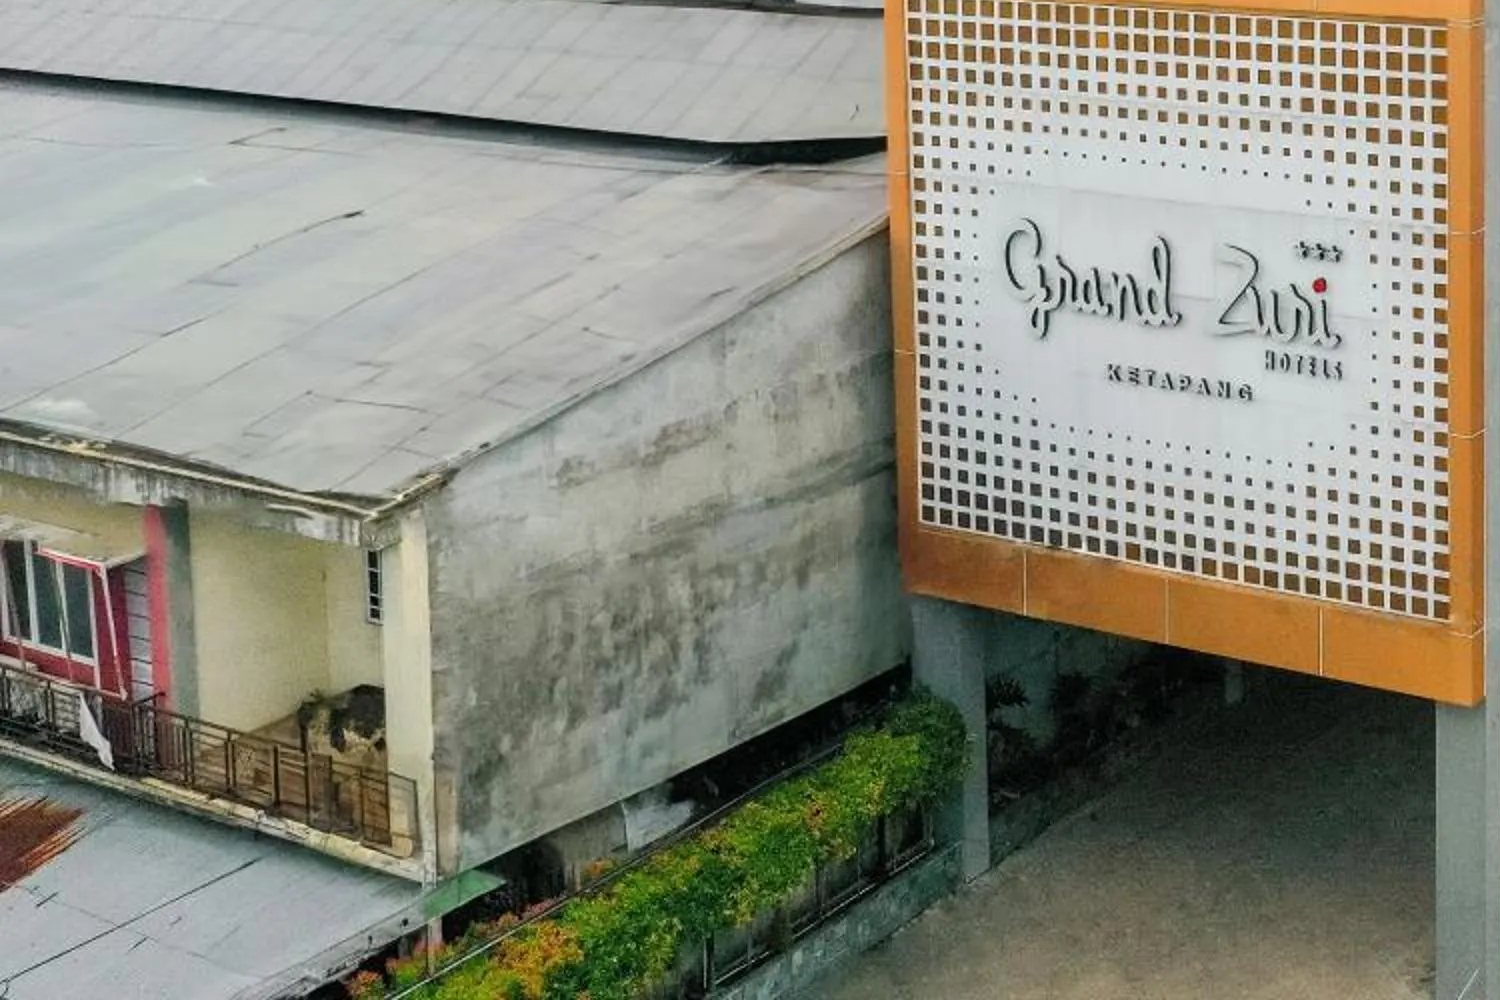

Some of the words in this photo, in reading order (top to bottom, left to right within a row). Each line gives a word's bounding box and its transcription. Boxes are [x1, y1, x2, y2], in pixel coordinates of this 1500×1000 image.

[1005, 216, 1183, 341] Grand
[1214, 243, 1342, 348] Zuri
[1107, 363, 1253, 401] KETAPANG
[1265, 350, 1343, 380] HOTELS
